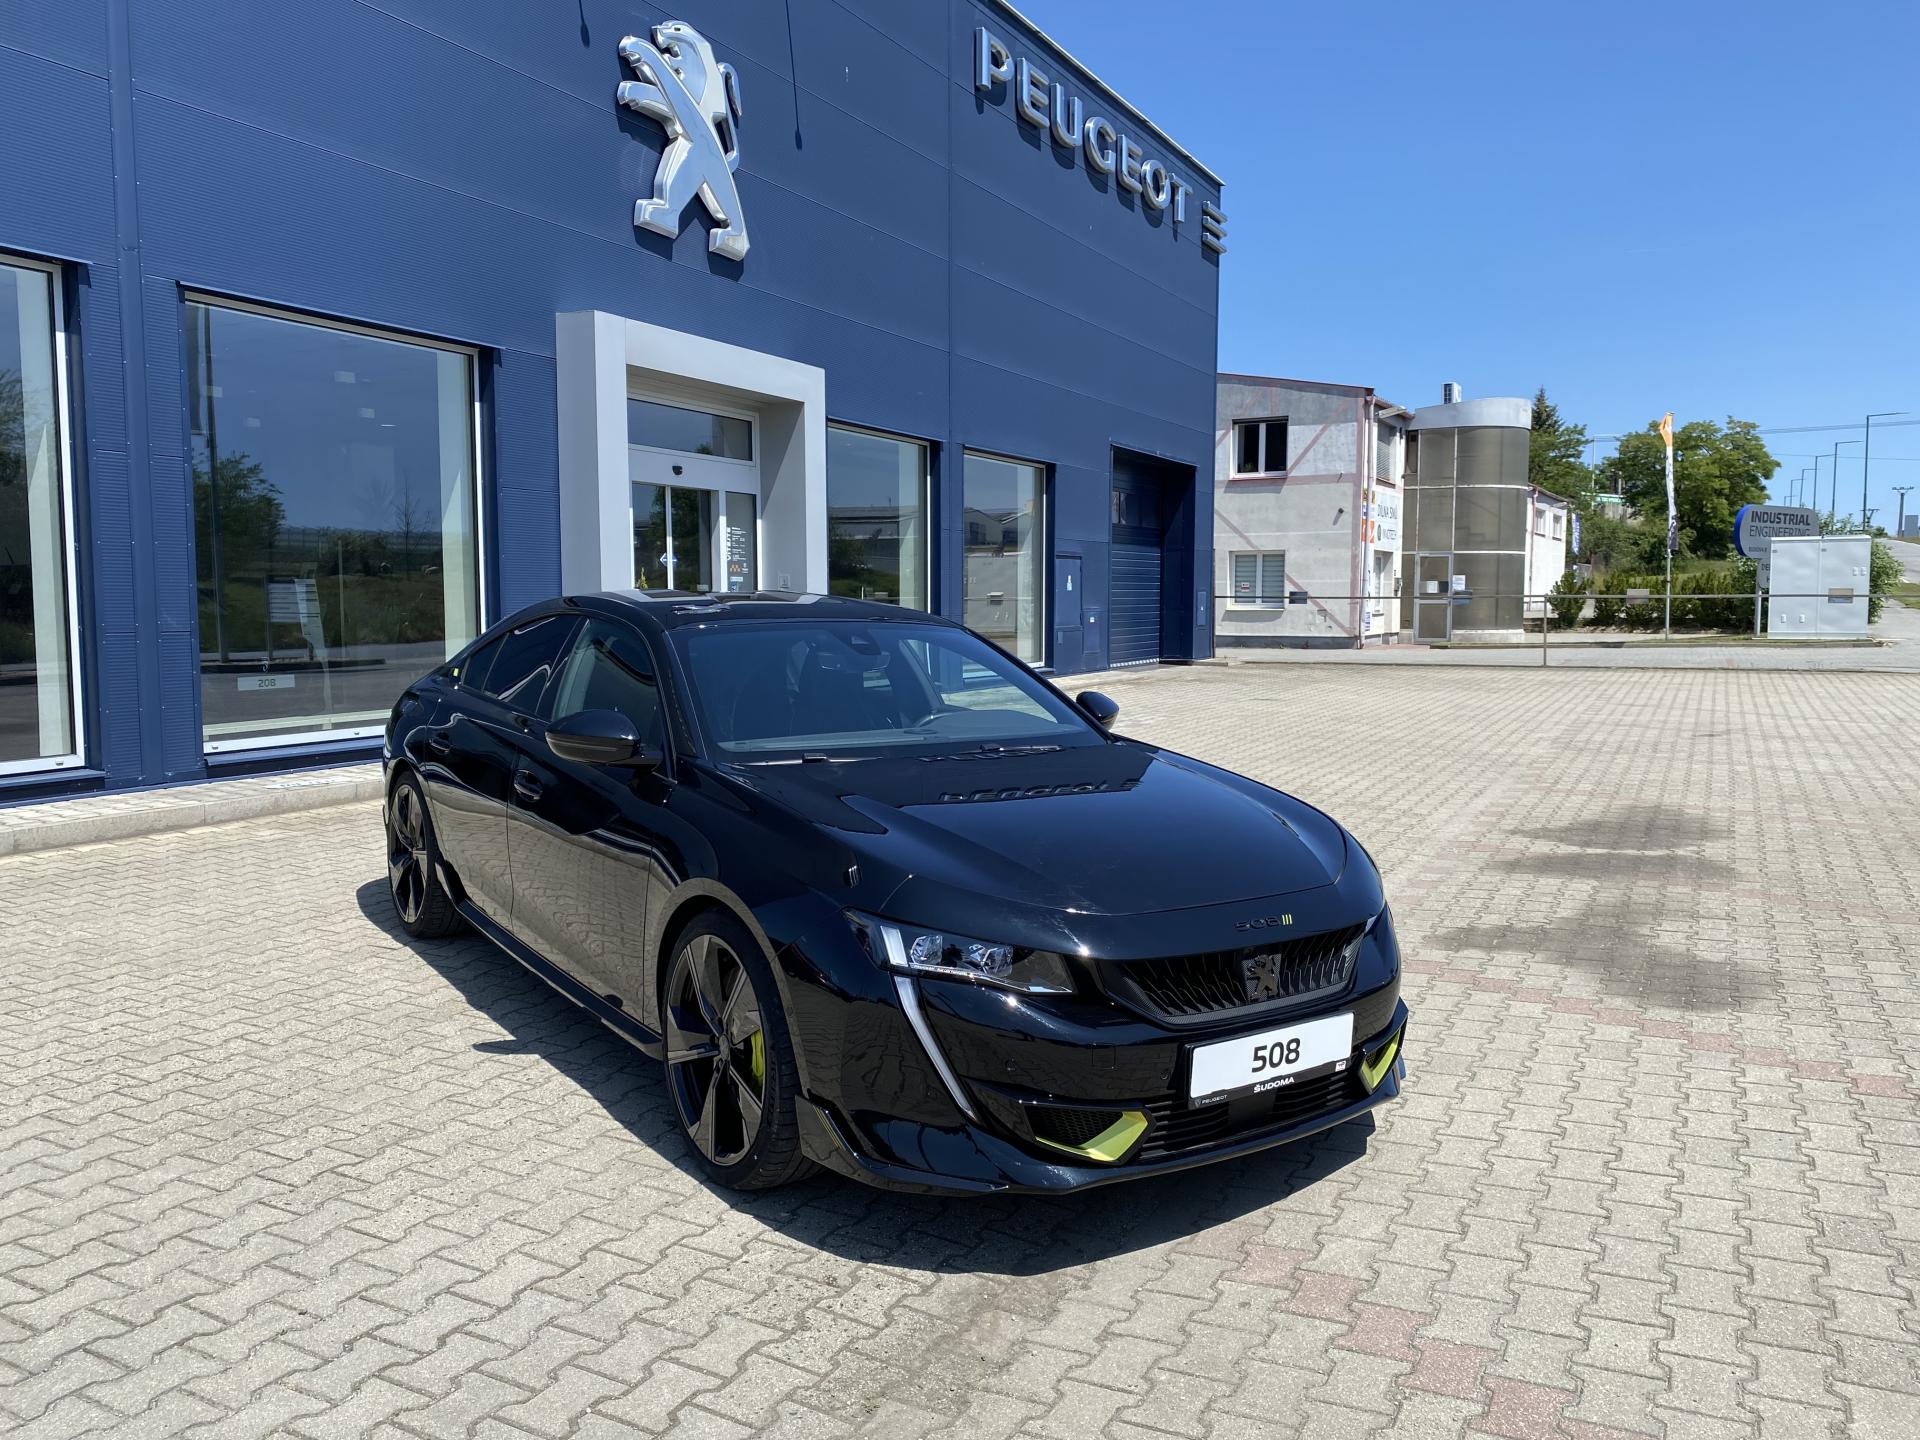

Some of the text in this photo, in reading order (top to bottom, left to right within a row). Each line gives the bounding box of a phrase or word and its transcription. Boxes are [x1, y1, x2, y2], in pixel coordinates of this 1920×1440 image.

[975, 26, 1193, 224] PEUGEOT
[1751, 510, 1811, 526] INDUSTRIAL
[257, 678, 276, 688] 208
[1251, 1037, 1301, 1073] 508
[1253, 1077, 1295, 1094] ŠUDOMA
[1202, 1094, 1227, 1104] PEUGEOT
